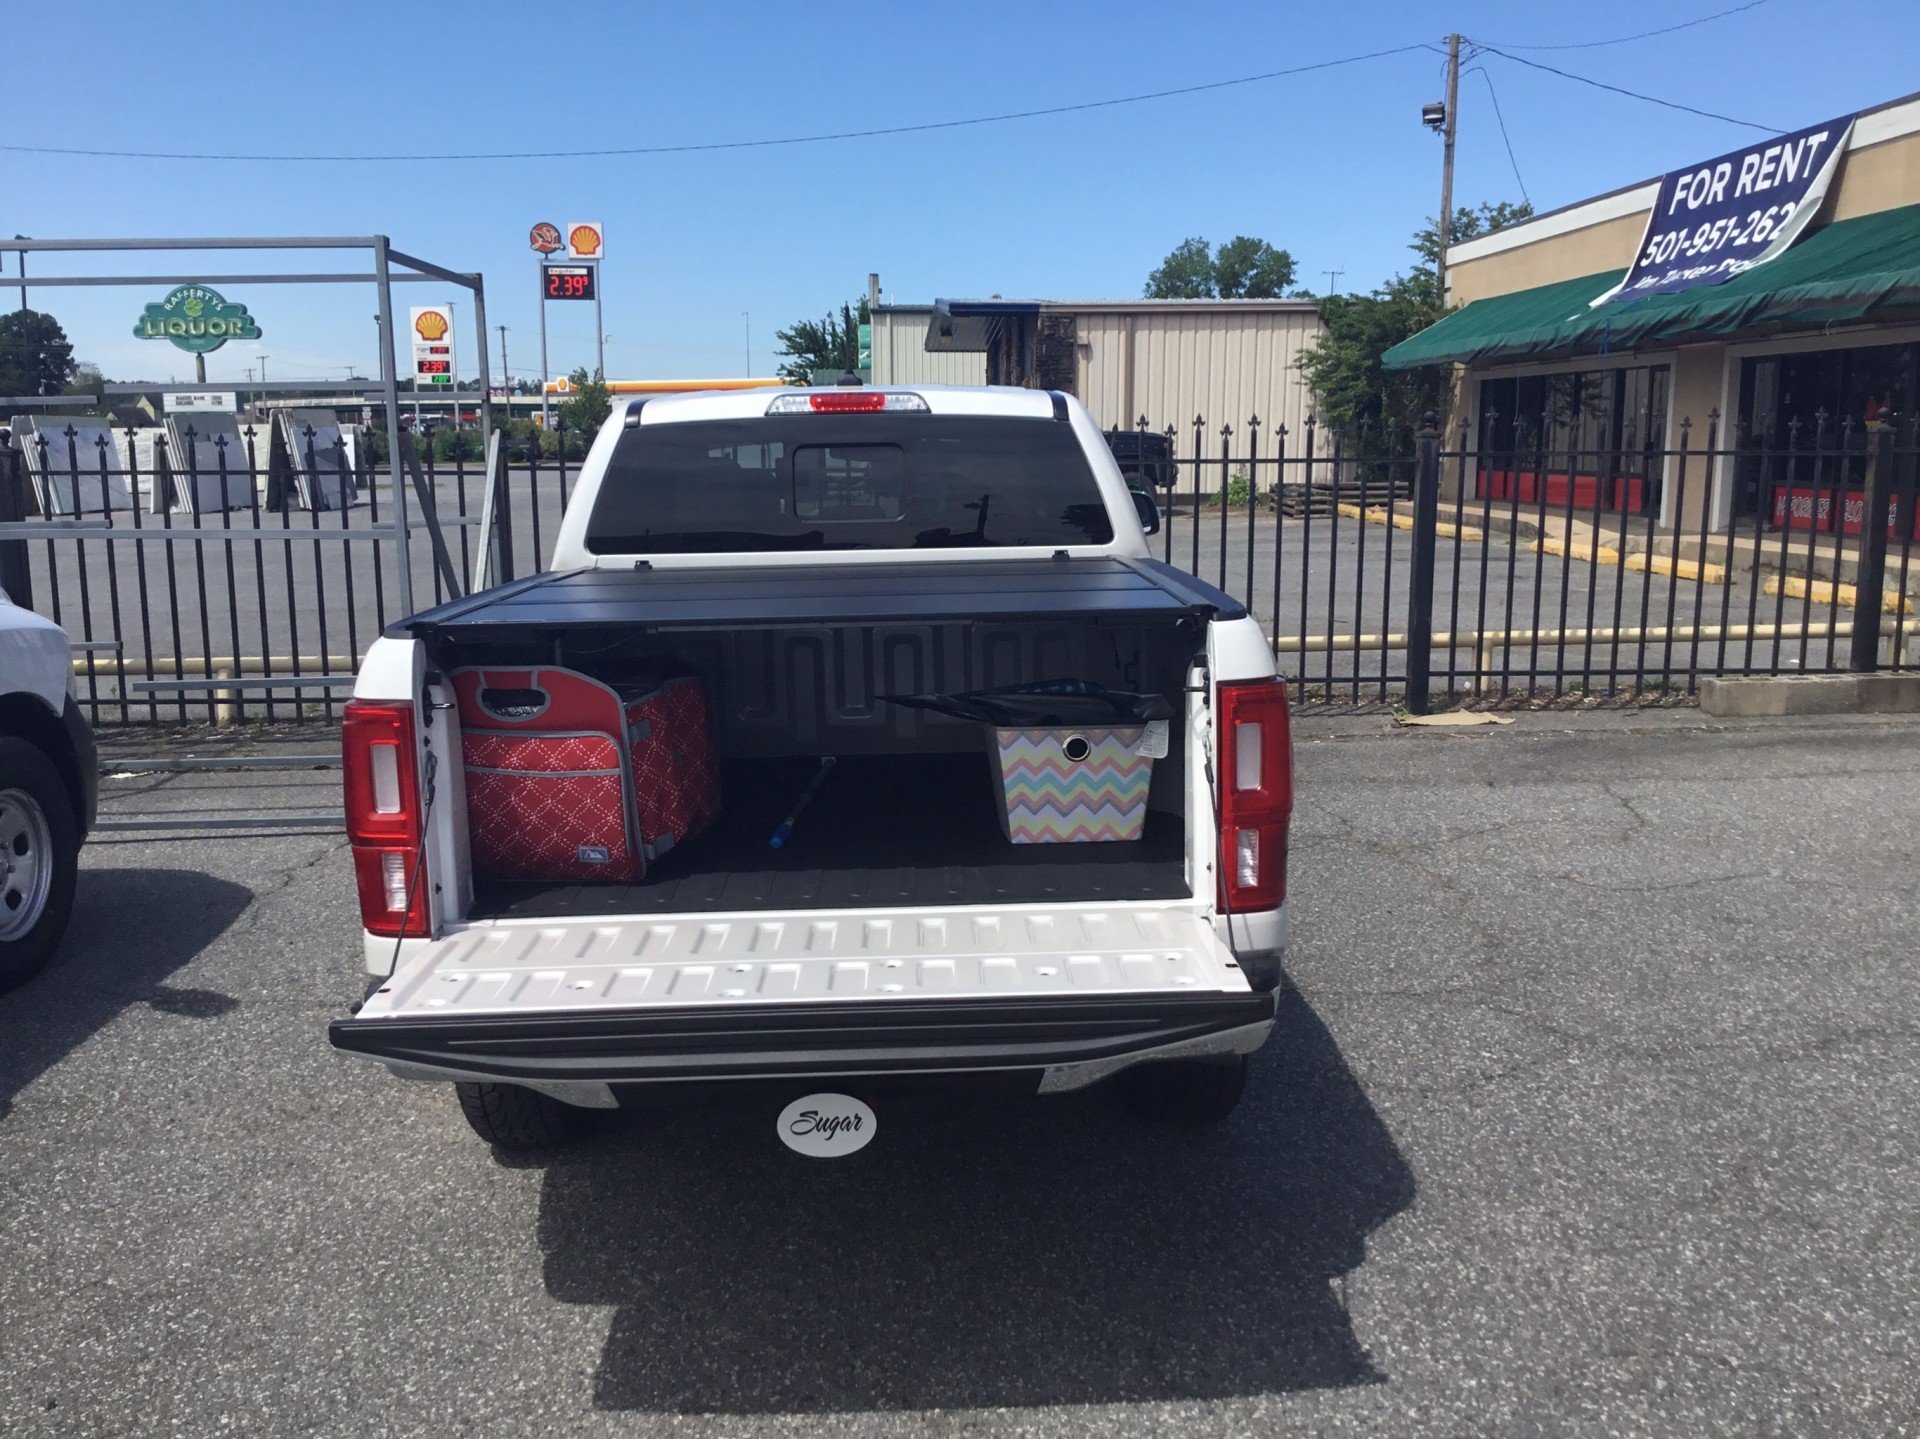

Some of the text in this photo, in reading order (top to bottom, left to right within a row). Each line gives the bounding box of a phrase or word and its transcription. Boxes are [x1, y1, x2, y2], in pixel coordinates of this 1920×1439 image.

[1668, 131, 1829, 216] FOR RENT
[1640, 202, 1796, 268] 501-951-262
[144, 317, 243, 337] LIQUOR
[790, 1110, 863, 1141] Sugar
